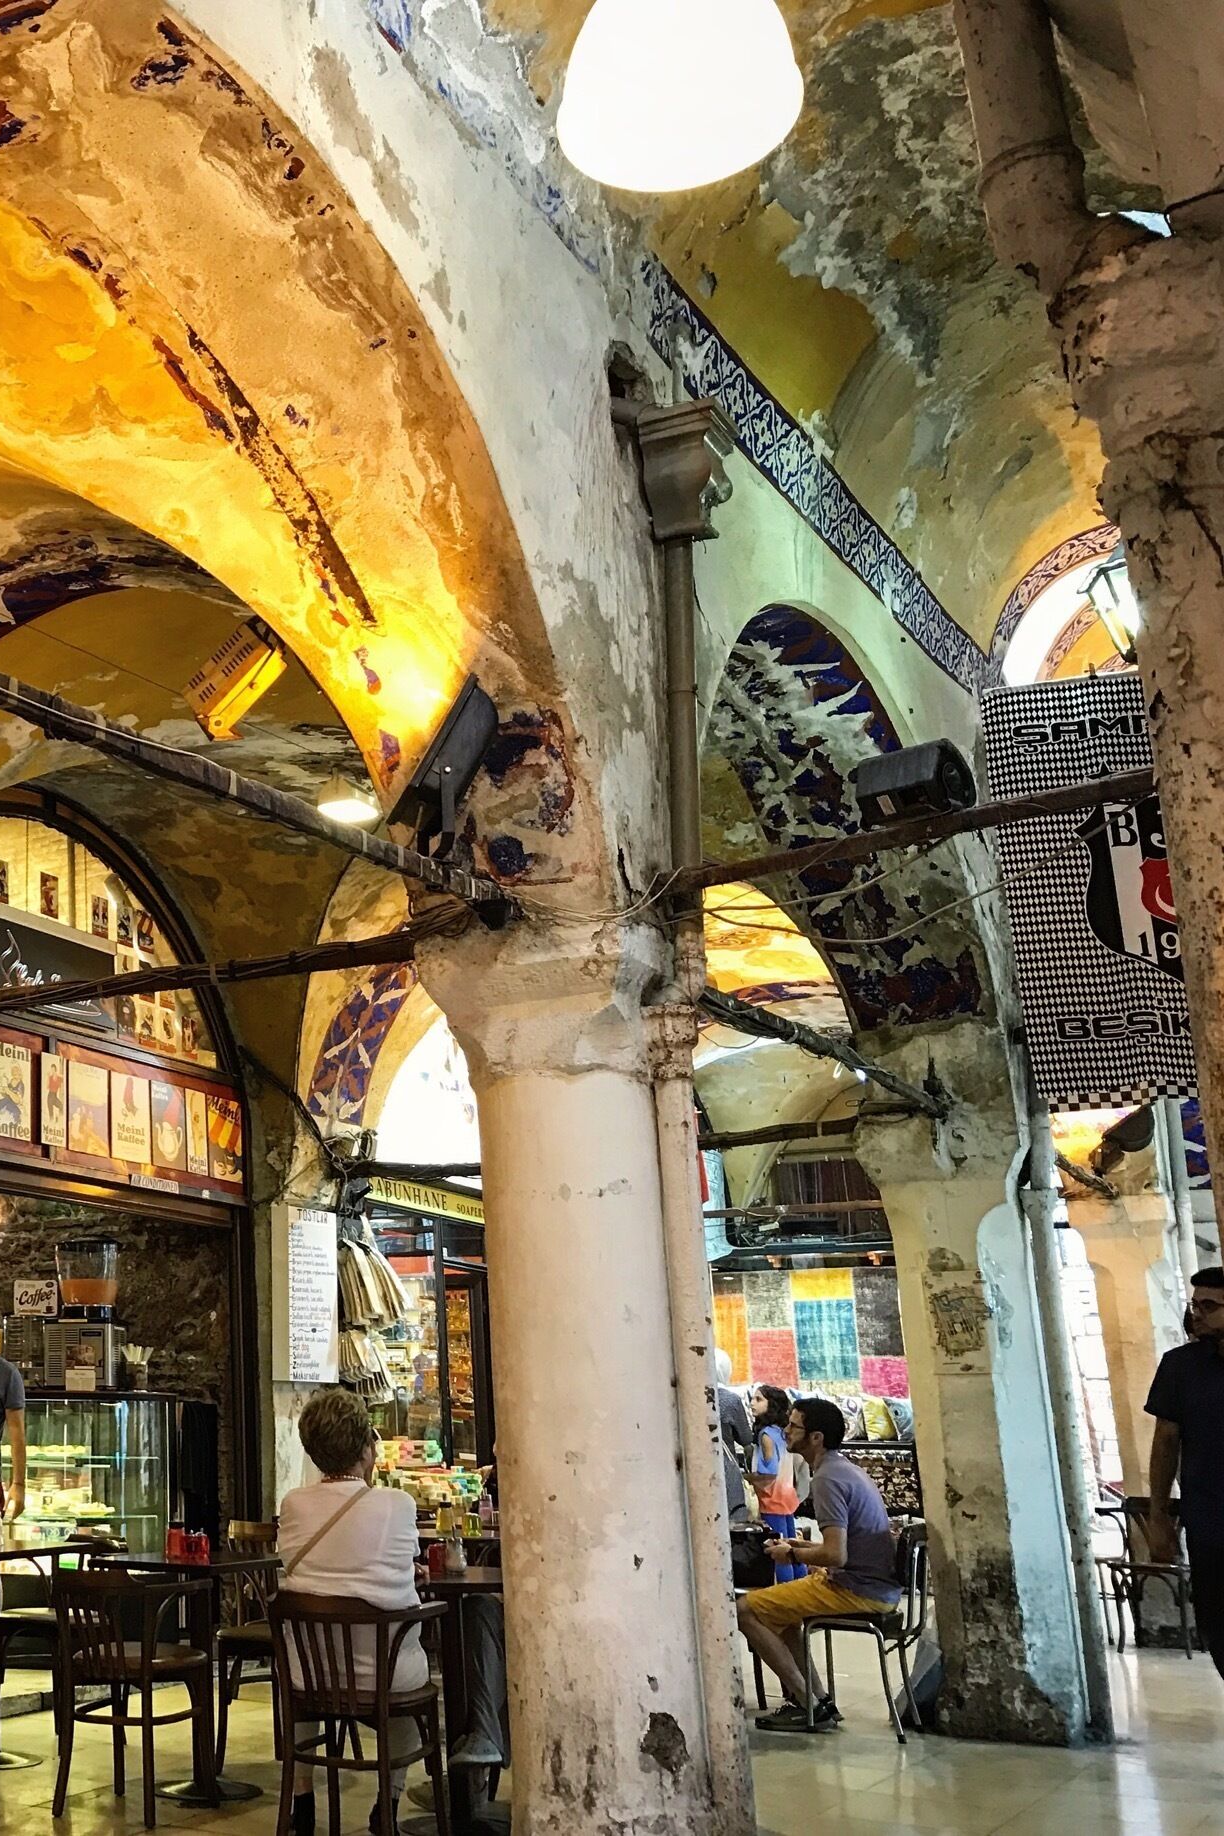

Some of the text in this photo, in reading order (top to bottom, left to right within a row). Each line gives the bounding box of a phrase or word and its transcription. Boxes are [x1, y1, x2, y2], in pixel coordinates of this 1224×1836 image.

[43, 1124, 64, 1138] Meinl
[117, 1122, 145, 1137] Meinl
[117, 1132, 146, 1146] Kaffee
[368, 1179, 484, 1218] SABUNHANE SOAPER
[19, 1288, 53, 1306] Coffee
